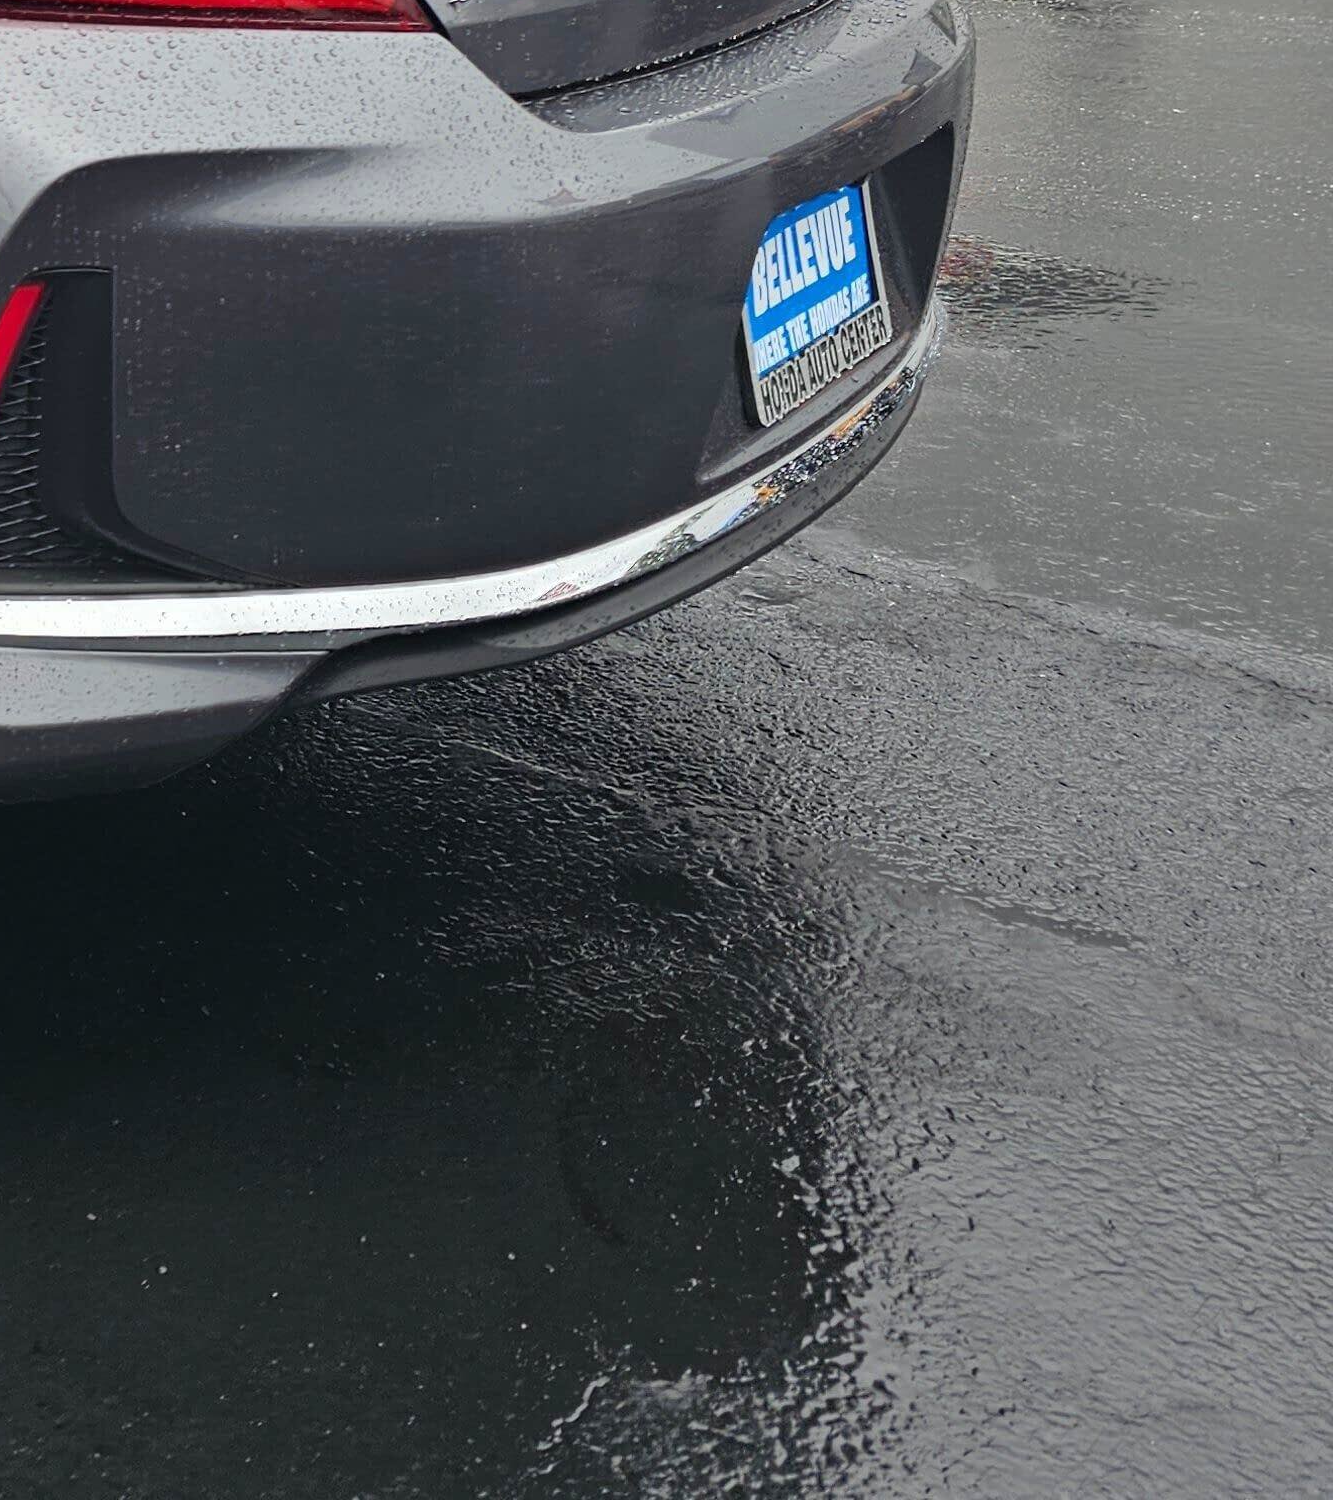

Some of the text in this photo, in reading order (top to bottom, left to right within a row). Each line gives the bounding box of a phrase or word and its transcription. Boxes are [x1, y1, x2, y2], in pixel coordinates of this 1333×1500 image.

[751, 196, 857, 318] BELLEVUE
[785, 311, 811, 352] THE
[808, 286, 852, 340] HONDAS
[850, 273, 871, 313] ARE
[759, 304, 888, 423] HONDA AUTO CENTER
